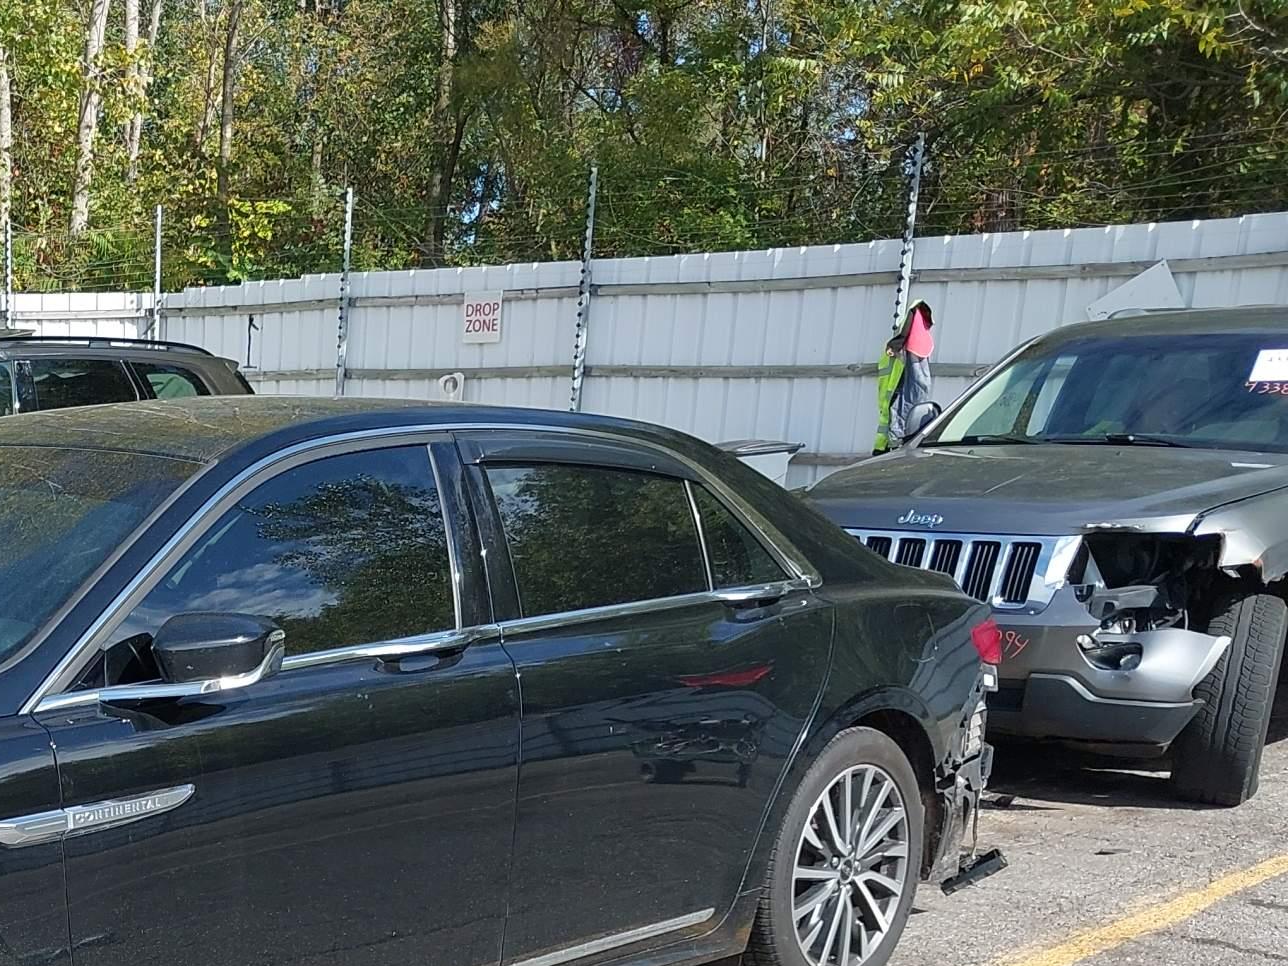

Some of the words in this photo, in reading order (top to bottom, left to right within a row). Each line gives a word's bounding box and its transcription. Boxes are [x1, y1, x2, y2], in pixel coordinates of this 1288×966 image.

[466, 302, 500, 317] DROP
[466, 318, 498, 333] ZONE
[898, 509, 944, 529] Jeep
[75, 797, 161, 824] CONTINENTAL
